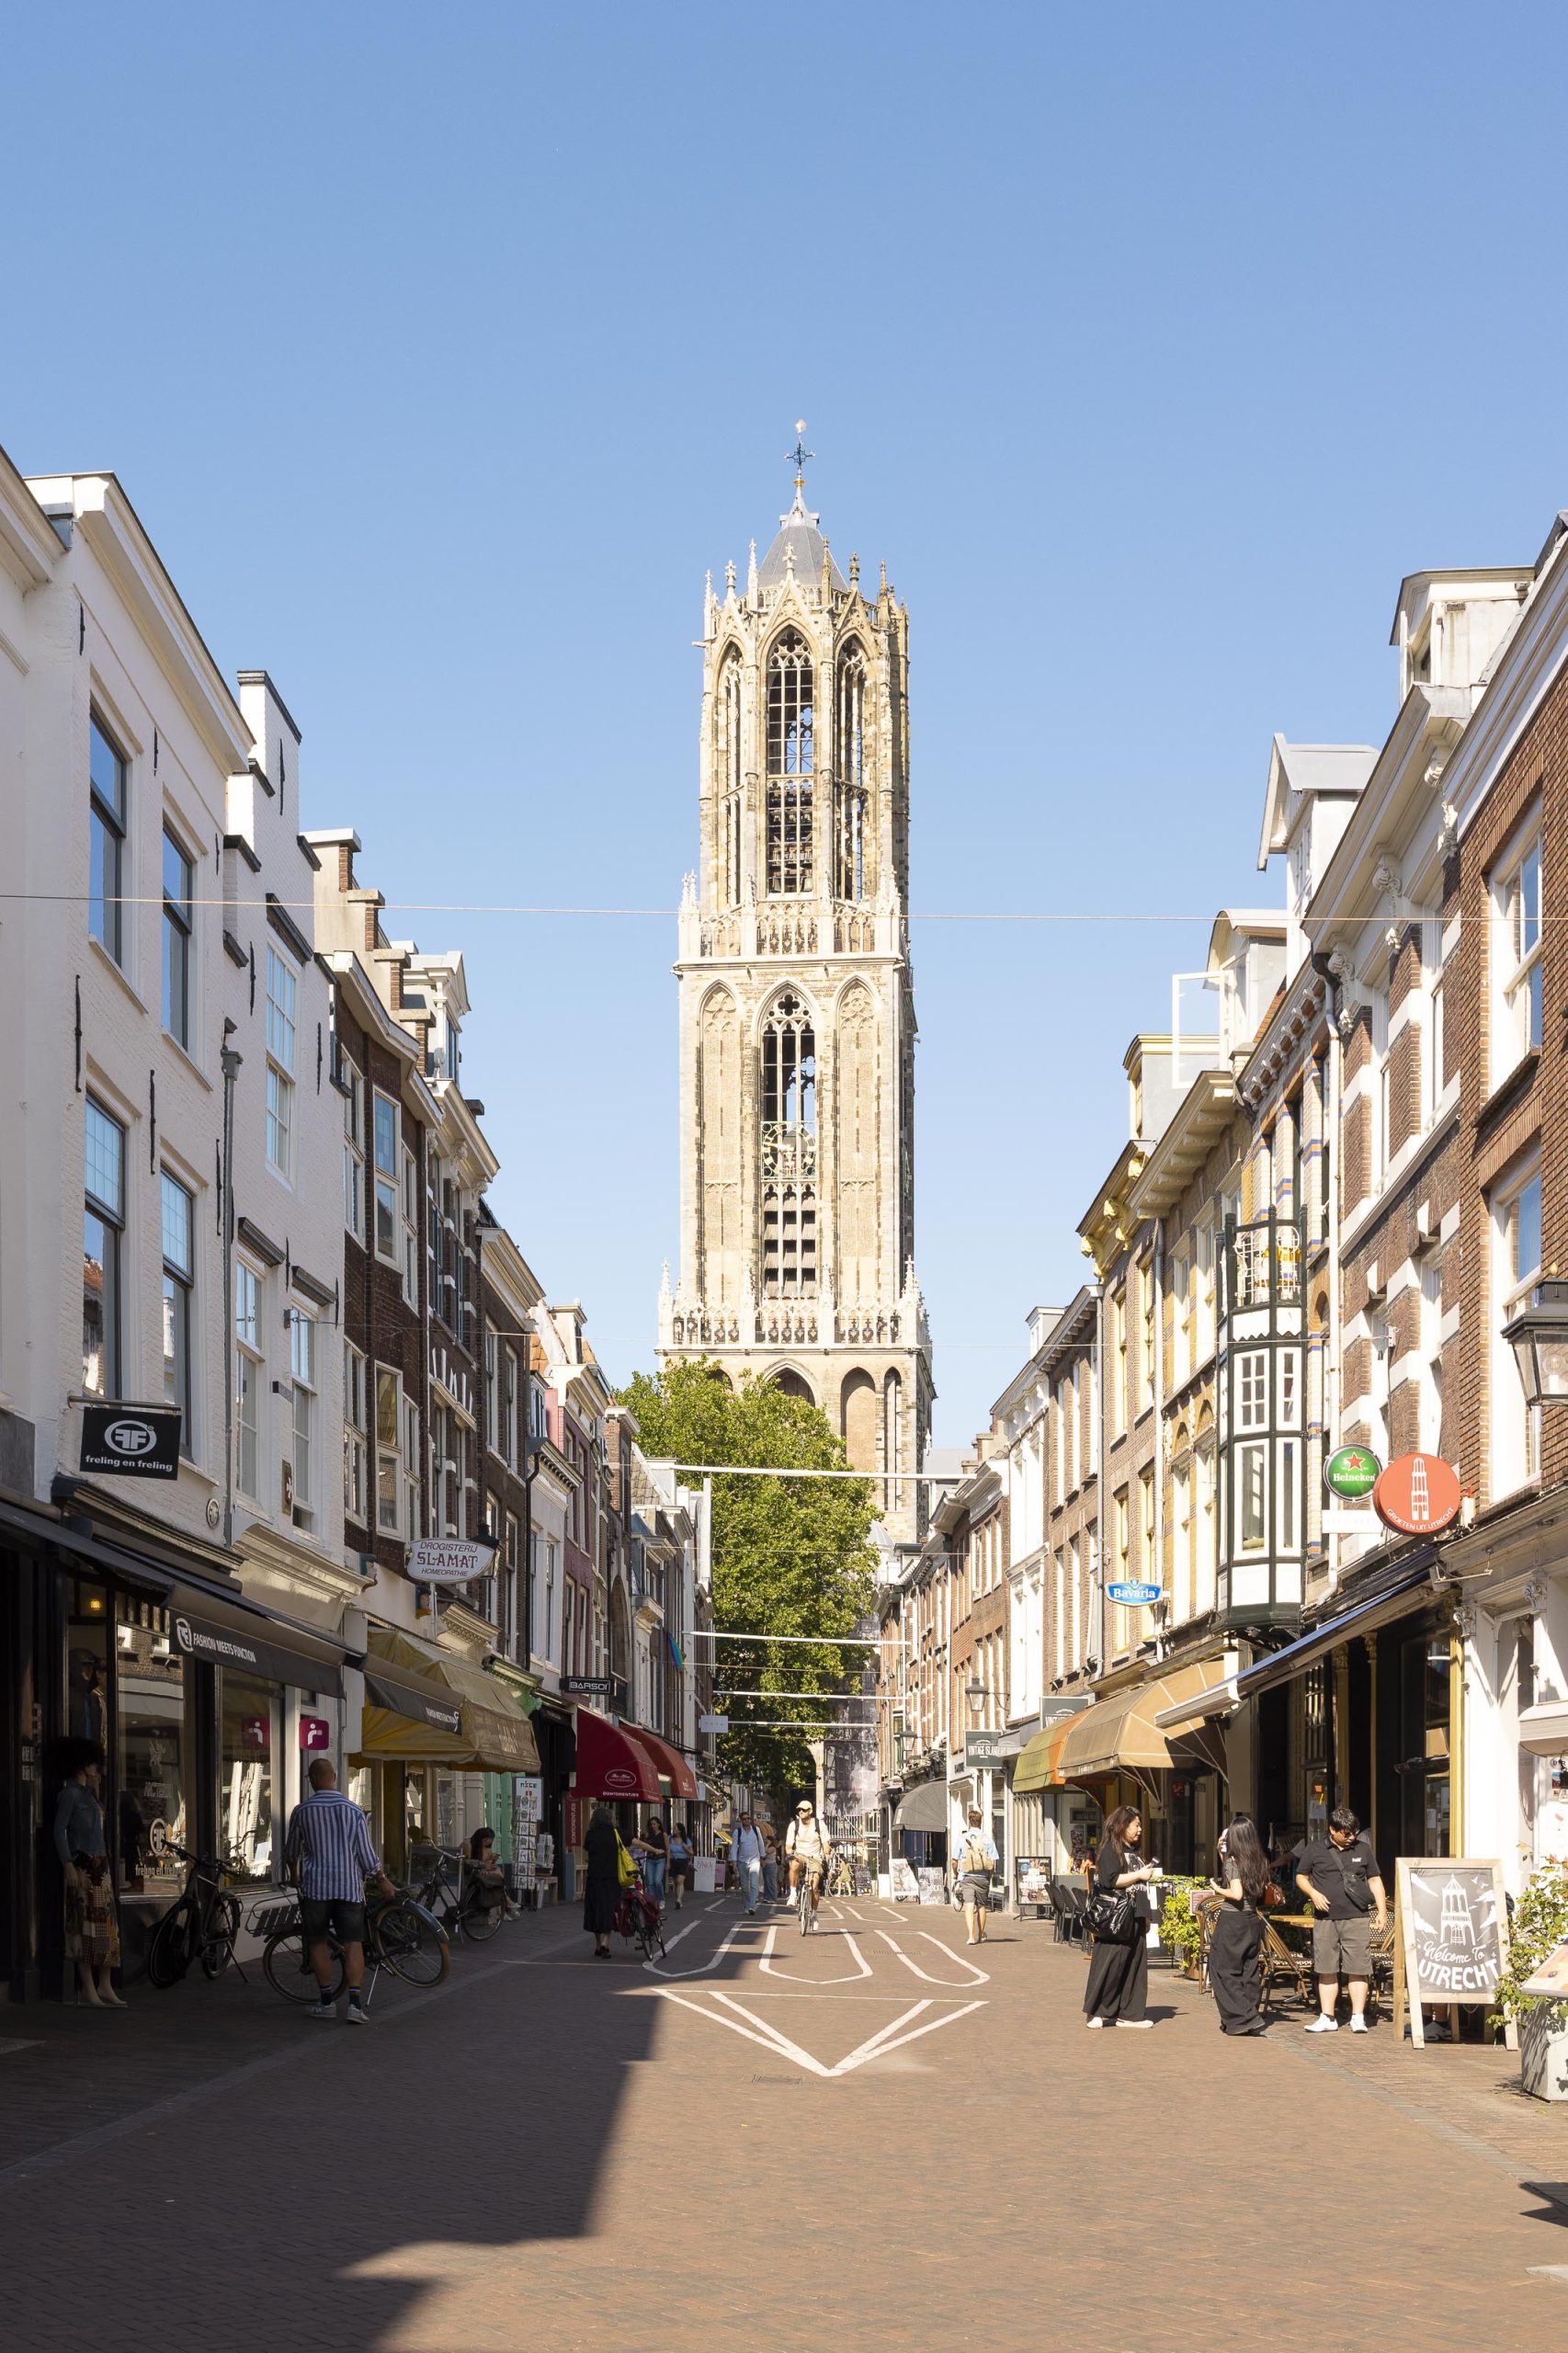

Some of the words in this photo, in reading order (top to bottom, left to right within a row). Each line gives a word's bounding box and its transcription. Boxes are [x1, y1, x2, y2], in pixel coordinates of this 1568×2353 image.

[85, 1455, 120, 1466] freling
[138, 1461, 173, 1472] freling
[1334, 1473, 1375, 1482] Heineken
[1387, 1508, 1415, 1530] GROETEN
[1427, 1506, 1455, 1529] UTRECHT
[420, 1542, 477, 1552] DROGISTERIJ
[417, 1552, 478, 1569] SLAMAT
[421, 1568, 469, 1576] HOMEOPATHIE
[1113, 1587, 1155, 1598] Bavaria
[193, 1632, 216, 1651] FASHION
[1423, 1940, 1471, 1963] Welcome
[1471, 1944, 1487, 1960] To
[1418, 1959, 1500, 1991] UTRECHT
